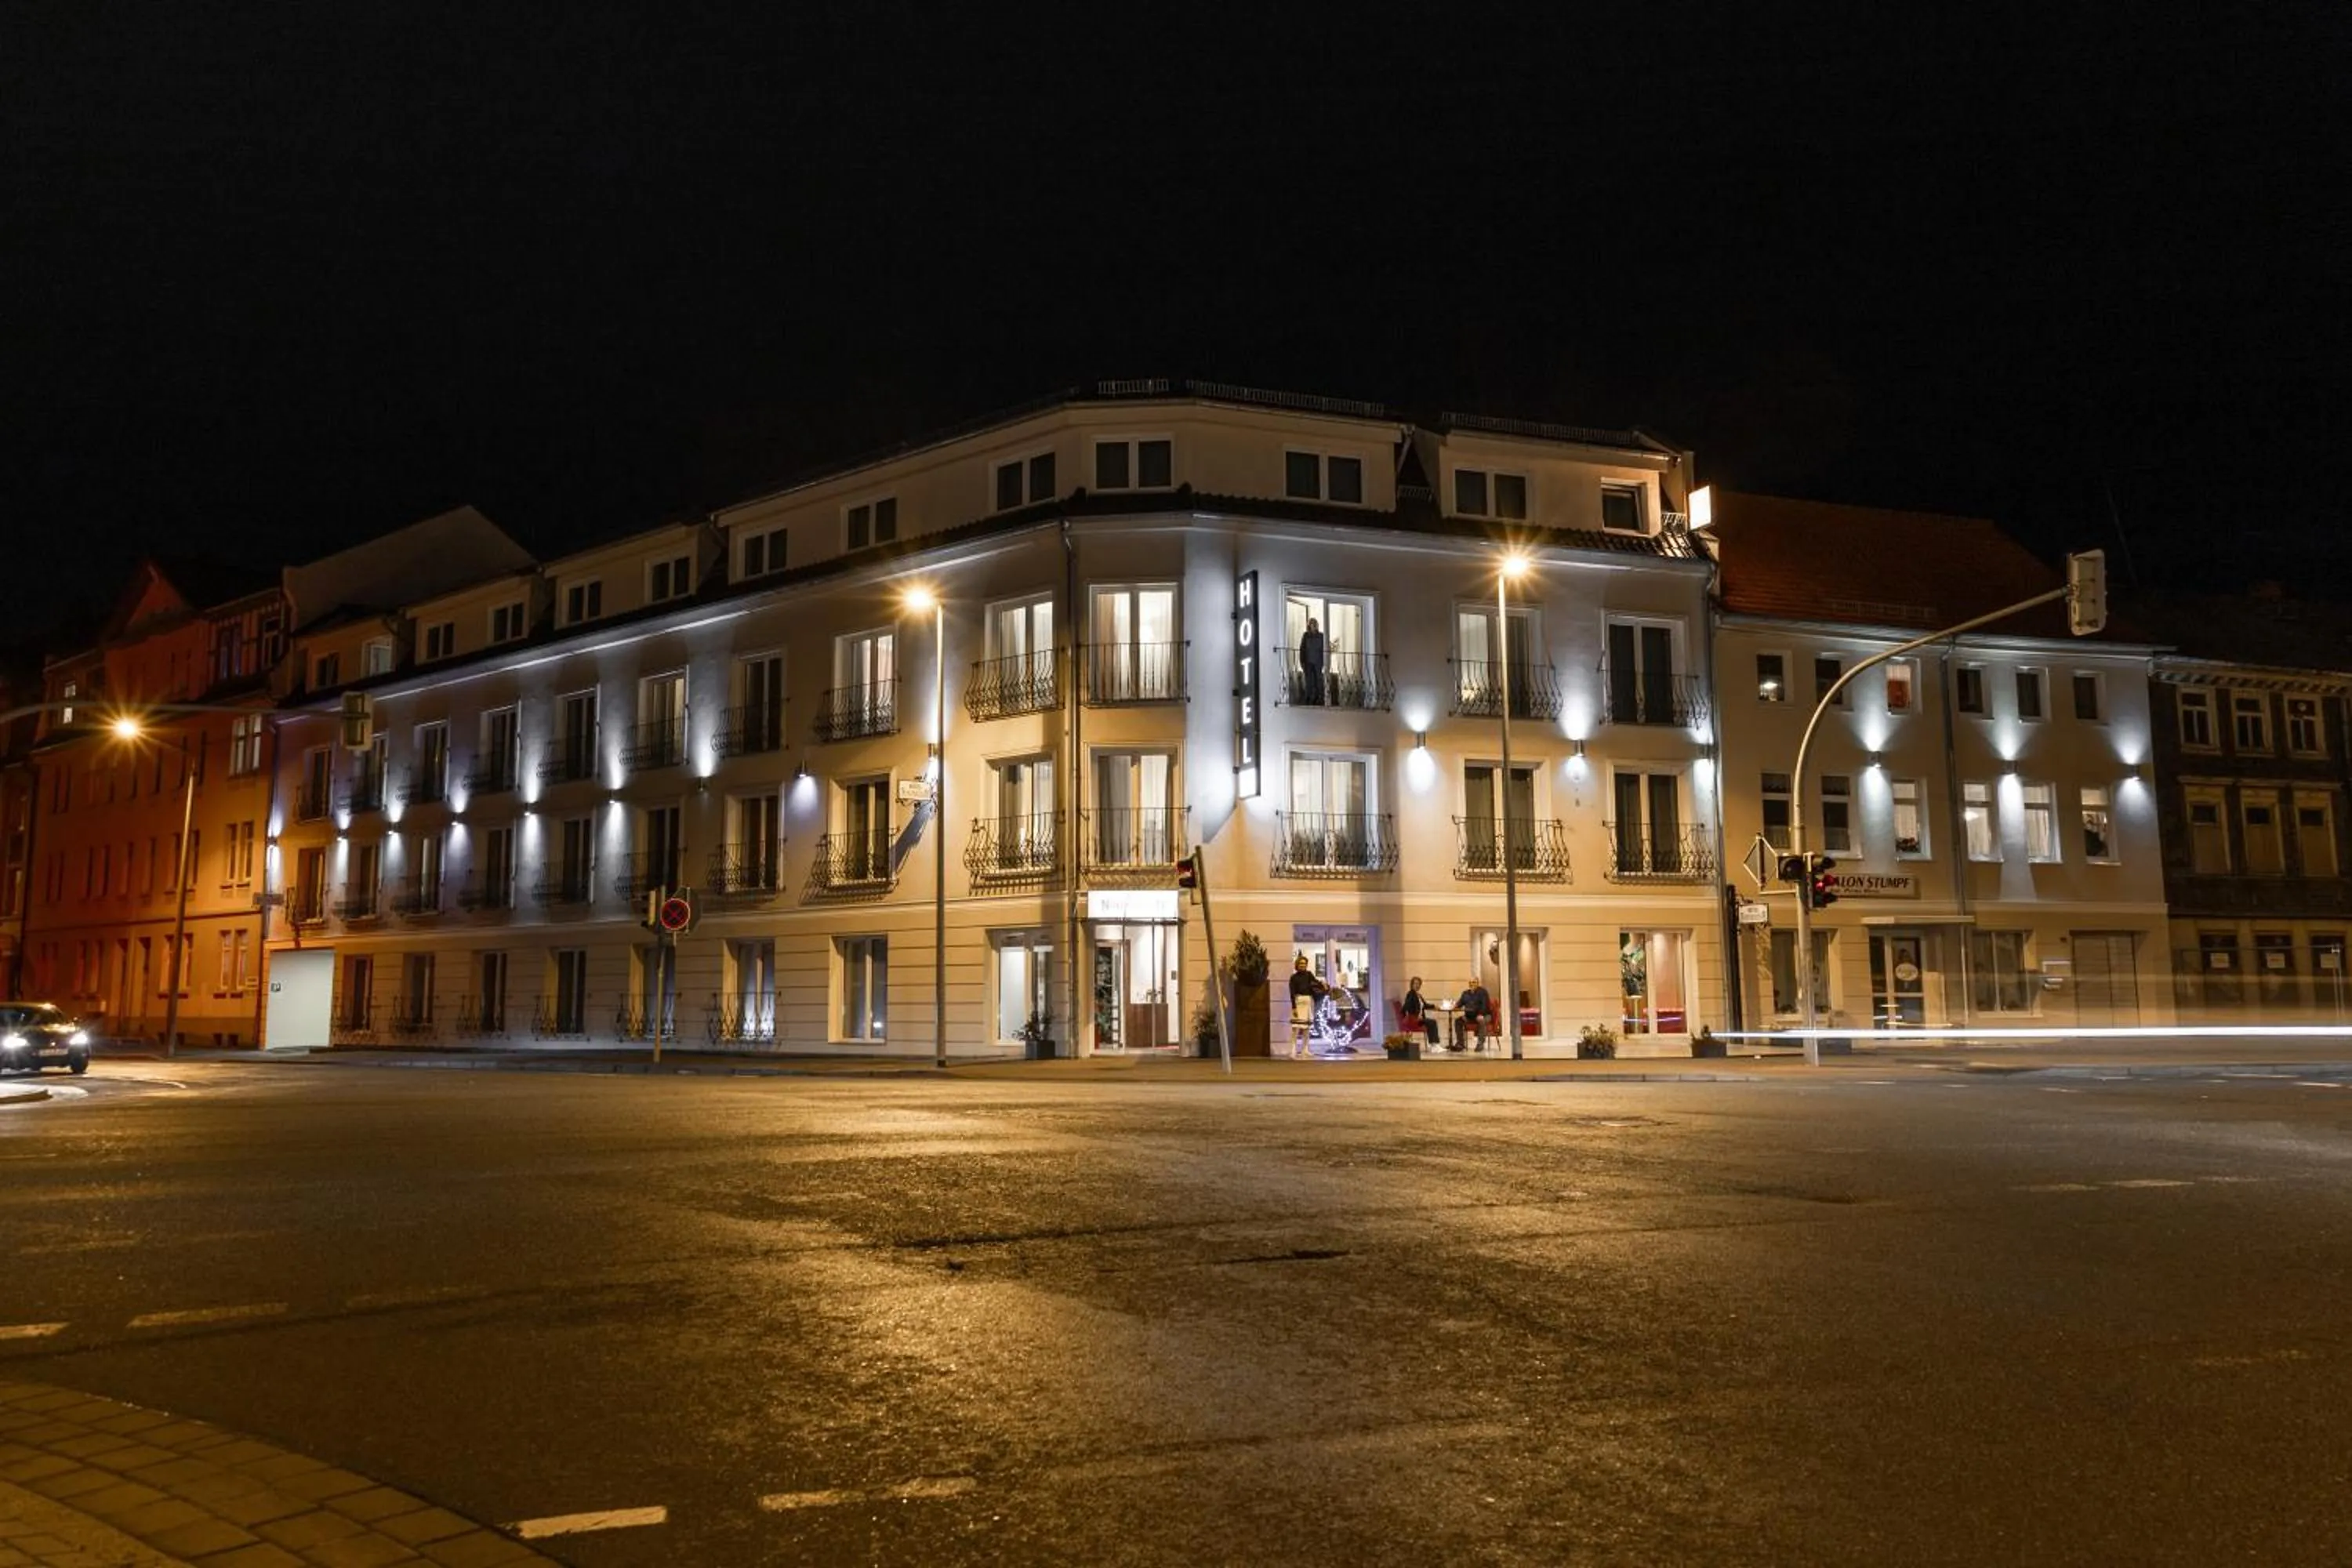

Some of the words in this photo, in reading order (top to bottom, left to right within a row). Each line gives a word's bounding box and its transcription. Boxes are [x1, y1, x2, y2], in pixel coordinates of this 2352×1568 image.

[1239, 579, 1252, 764] HOTEL
[1831, 876, 1864, 887] ALON
[1866, 877, 1911, 888] STUMPF
